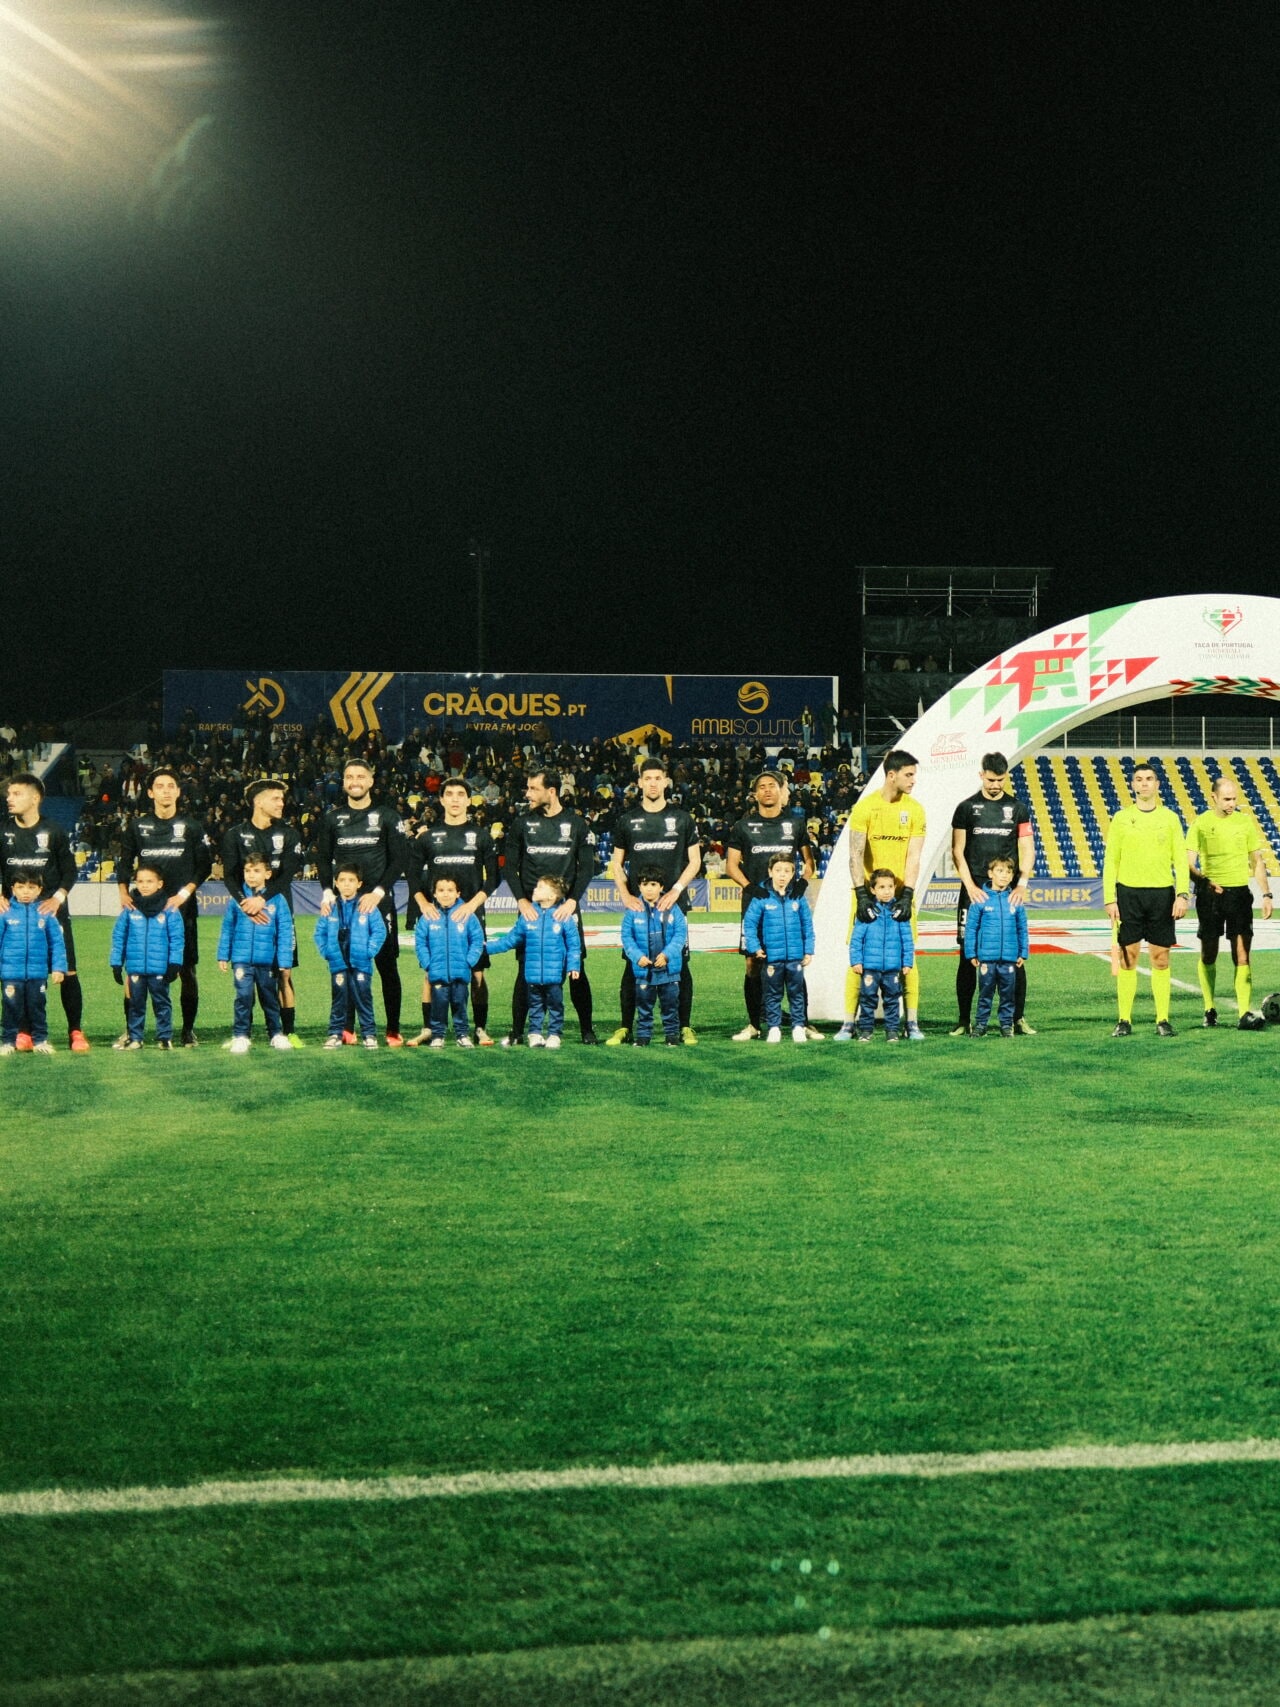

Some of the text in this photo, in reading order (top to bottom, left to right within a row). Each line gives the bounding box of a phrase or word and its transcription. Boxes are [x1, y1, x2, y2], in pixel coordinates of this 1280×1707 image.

[518, 723, 539, 731] JOG
[195, 890, 232, 911] Spor
[587, 888, 611, 902] BLUE
[714, 887, 742, 900] PATR
[1024, 888, 1092, 902] ECNIFEX
